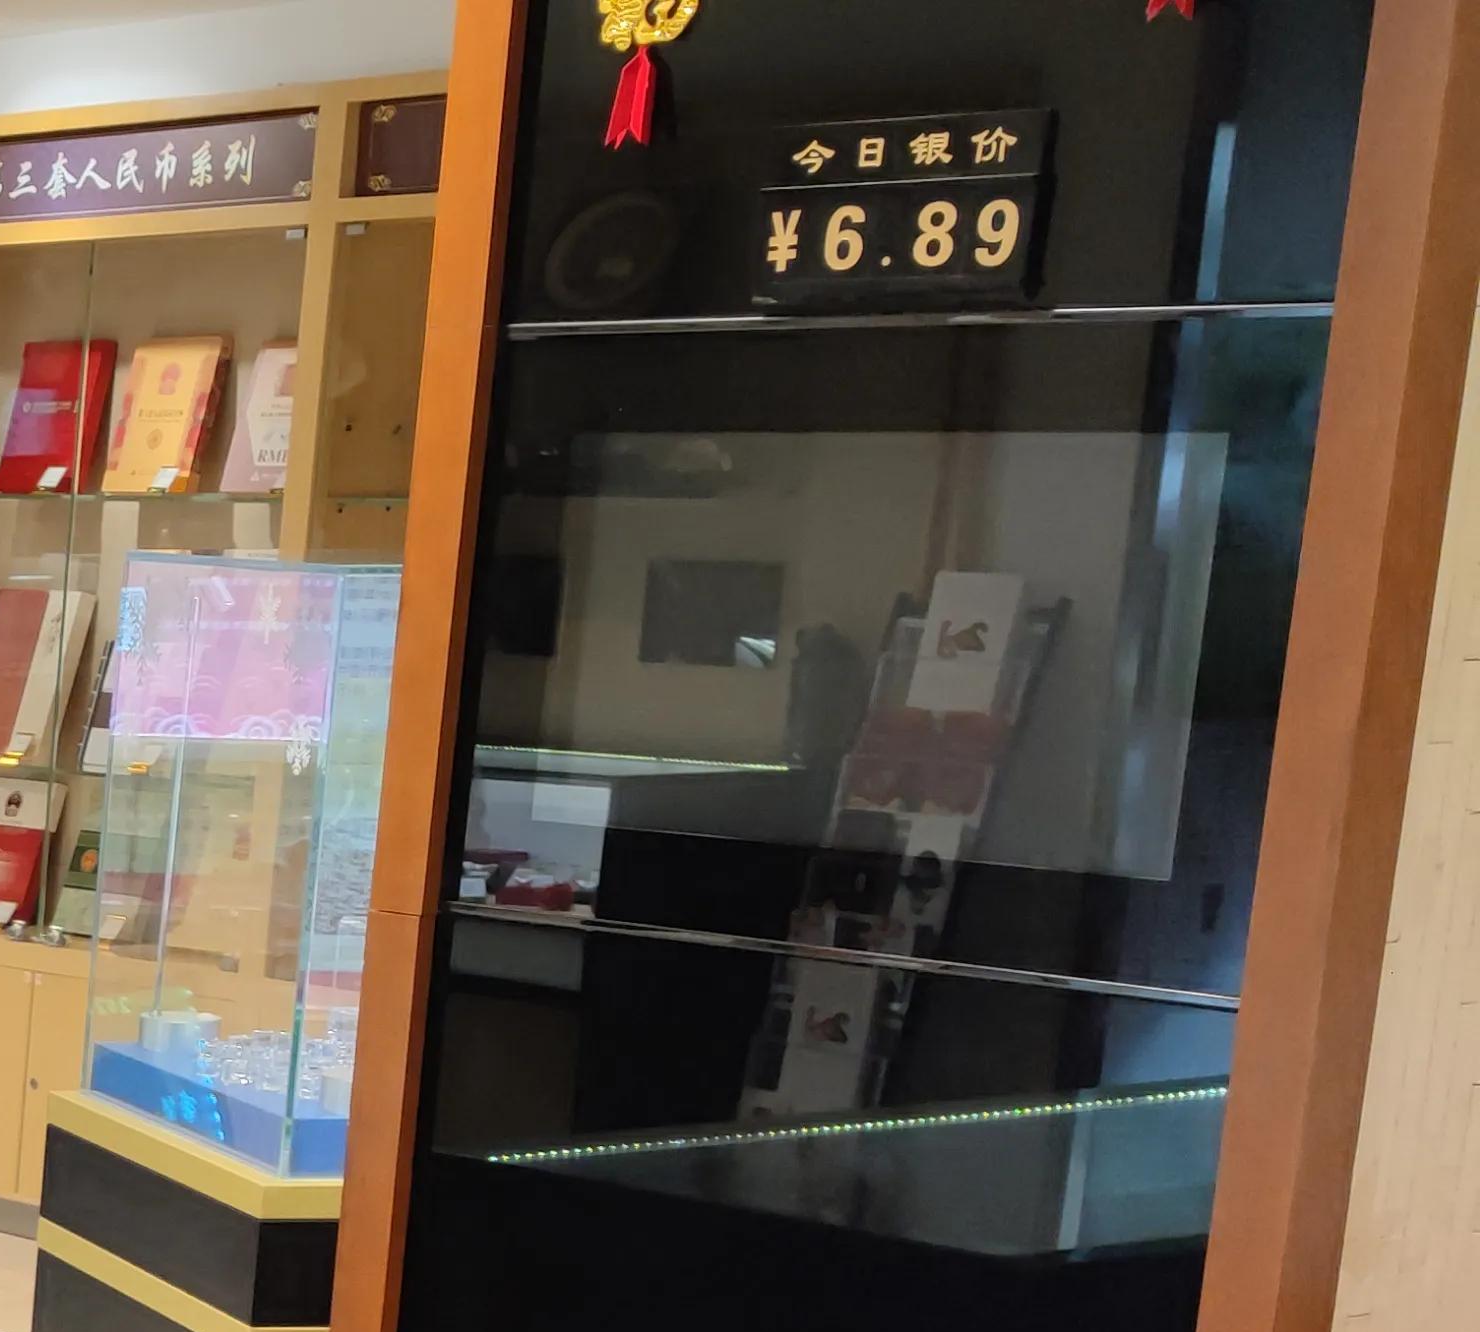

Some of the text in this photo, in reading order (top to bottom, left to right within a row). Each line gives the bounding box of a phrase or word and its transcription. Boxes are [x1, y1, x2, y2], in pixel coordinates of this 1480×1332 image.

[792, 126, 1019, 174] 今日银价
[766, 198, 1021, 273] ¥6.89
